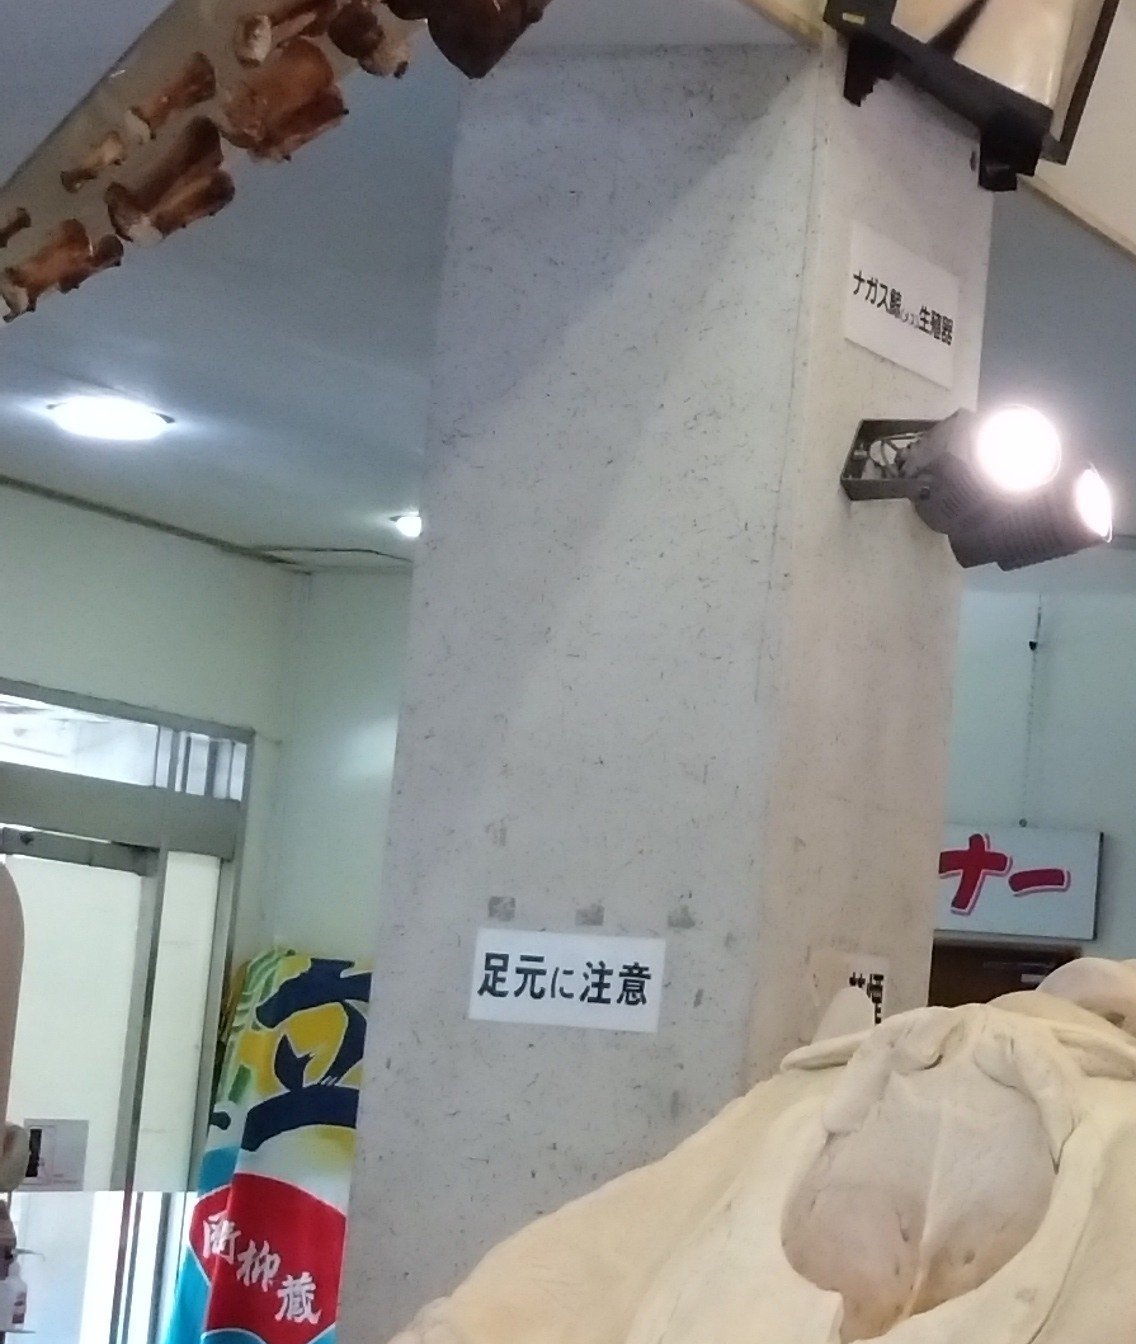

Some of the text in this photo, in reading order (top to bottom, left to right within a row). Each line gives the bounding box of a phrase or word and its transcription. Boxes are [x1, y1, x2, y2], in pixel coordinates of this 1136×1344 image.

[477, 952, 651, 1005] 足元に注意
